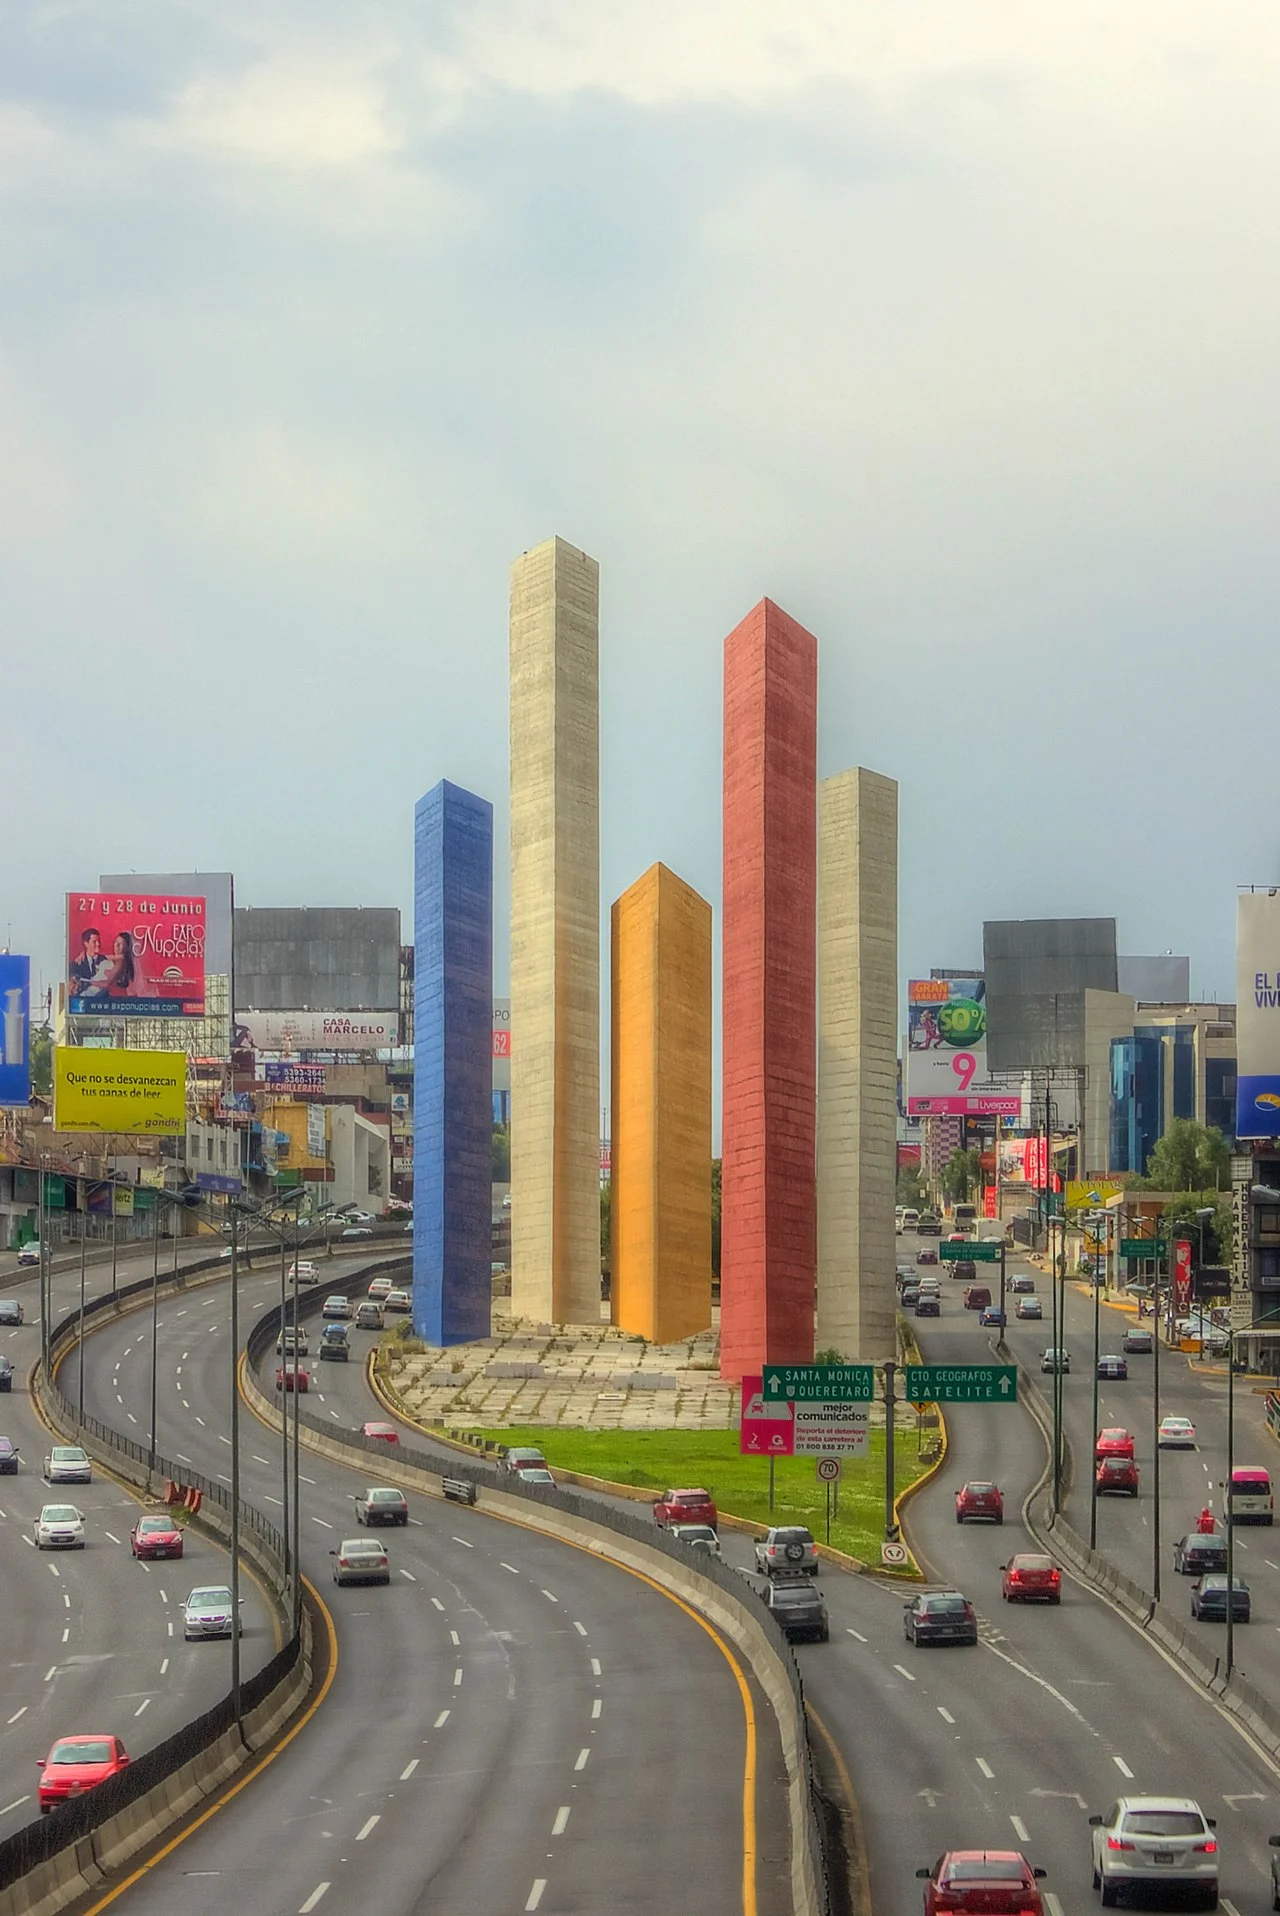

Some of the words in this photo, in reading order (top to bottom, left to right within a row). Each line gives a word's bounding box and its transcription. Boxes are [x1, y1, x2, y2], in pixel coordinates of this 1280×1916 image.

[79, 898, 95, 911] 27
[103, 901, 110, 914] y
[117, 900, 133, 912] 28
[140, 901, 156, 912] de
[162, 901, 202, 914] Junio
[1255, 973, 1272, 989] EL
[915, 982, 948, 992] GRAN
[323, 1026, 384, 1035] MARCELO
[952, 1053, 976, 1091] 9
[66, 1072, 87, 1085] Que
[90, 1075, 102, 1083] no
[104, 1076, 114, 1084] se
[116, 1074, 177, 1087] desvanezcan
[81, 1087, 97, 1096] tus
[130, 1088, 140, 1098] de
[980, 1100, 1017, 1110] Liverpool
[145, 1117, 180, 1128] gandhi
[1232, 1188, 1240, 1285] FARMACIA
[786, 1370, 821, 1381] SANTA
[828, 1370, 869, 1381] MONICA
[936, 1371, 992, 1382] GEOGRAFOS
[799, 1386, 870, 1397] QUERETARO
[911, 1386, 992, 1397] SATELITE
[823, 1403, 853, 1413] mejor
[796, 1411, 868, 1421] comunicados
[824, 1463, 834, 1473] 70
